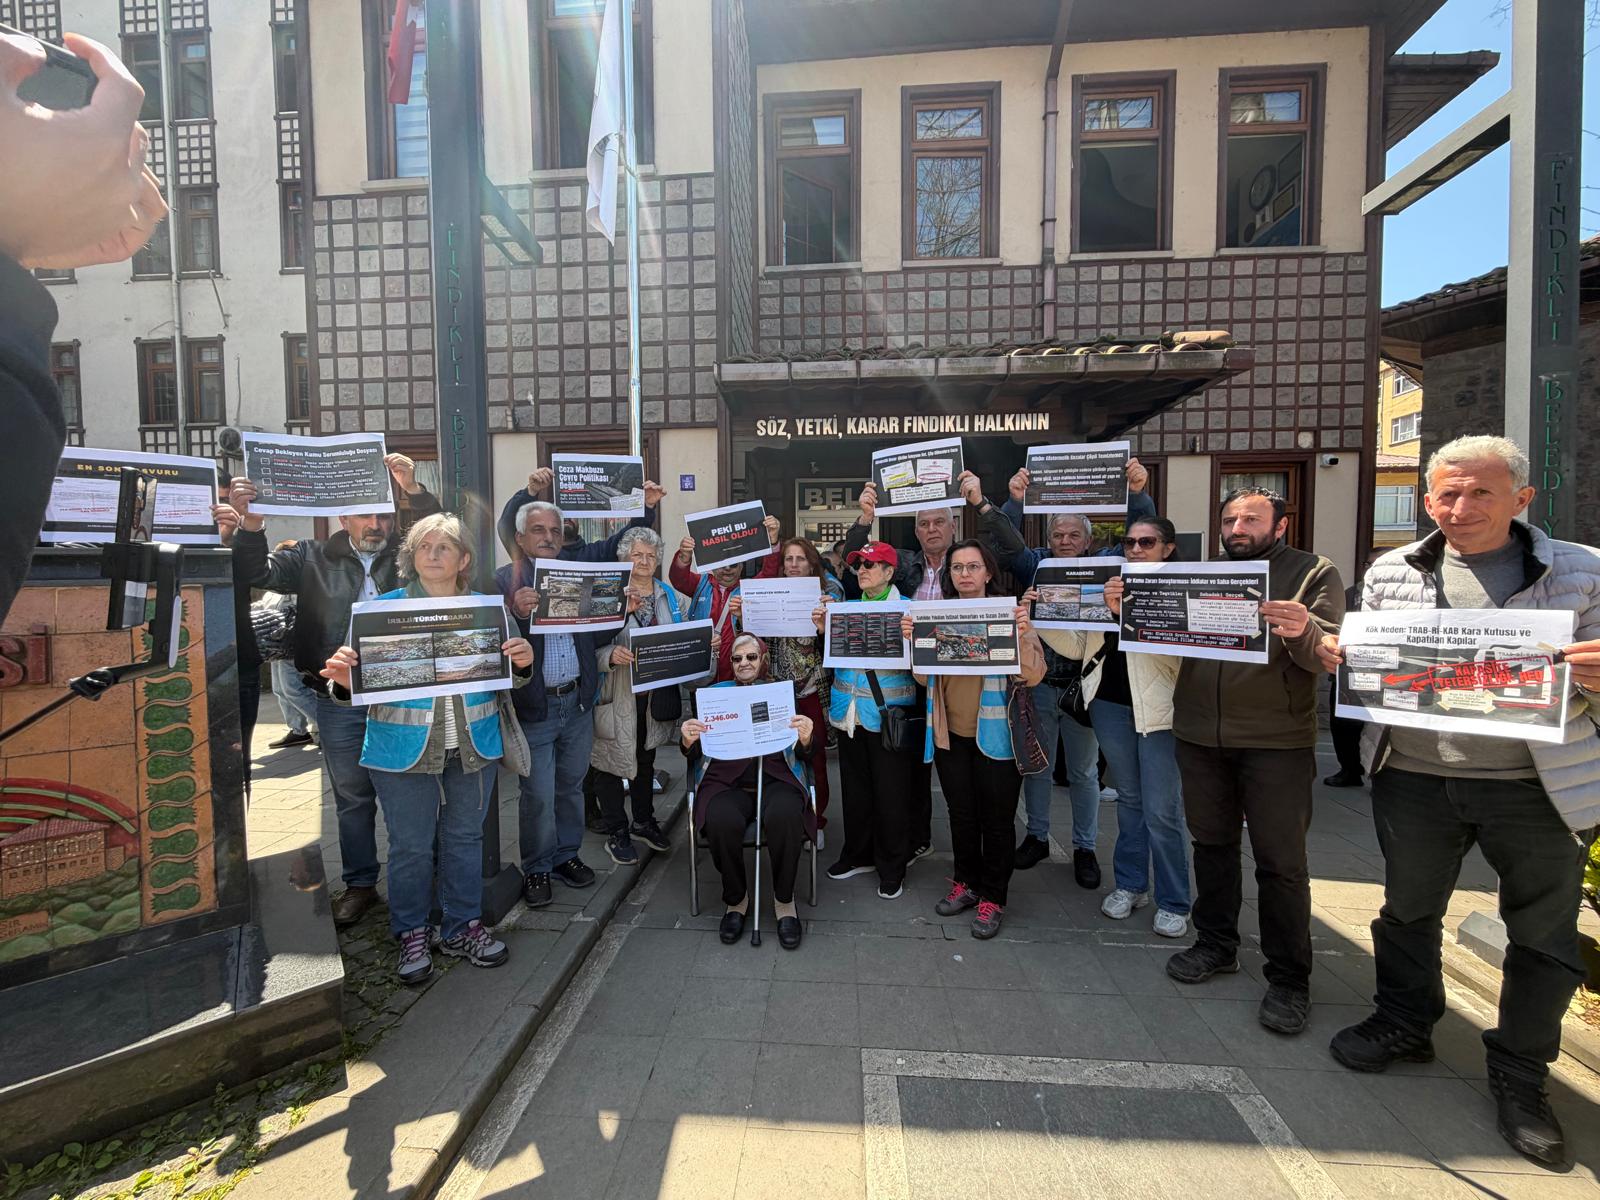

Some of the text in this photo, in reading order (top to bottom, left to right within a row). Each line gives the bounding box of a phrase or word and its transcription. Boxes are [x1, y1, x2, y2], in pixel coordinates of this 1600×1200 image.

[1547, 160, 1568, 341] FINDIKLI
[447, 229, 463, 382] FINDIKLI
[757, 413, 1050, 440] SÖZ, YETKİ, KARAR FINDIKLI HALKININ
[559, 474, 609, 482] Çevre Politikası
[804, 487, 861, 506] BEL
[711, 522, 747, 536] PEKİ BU
[702, 528, 758, 547] NASIL OLDU?
[1230, 578, 1259, 586] Gerçekleri
[1380, 626, 1407, 634] Neden:
[1408, 625, 1459, 635] TRAB-Rİ-KAB
[1461, 627, 1482, 636] Kara
[1484, 627, 1517, 637] Kutusu
[1519, 629, 1531, 637] ve
[1406, 635, 1477, 646] Kapatılan Kapılar
[704, 713, 739, 723] 2.346.000
